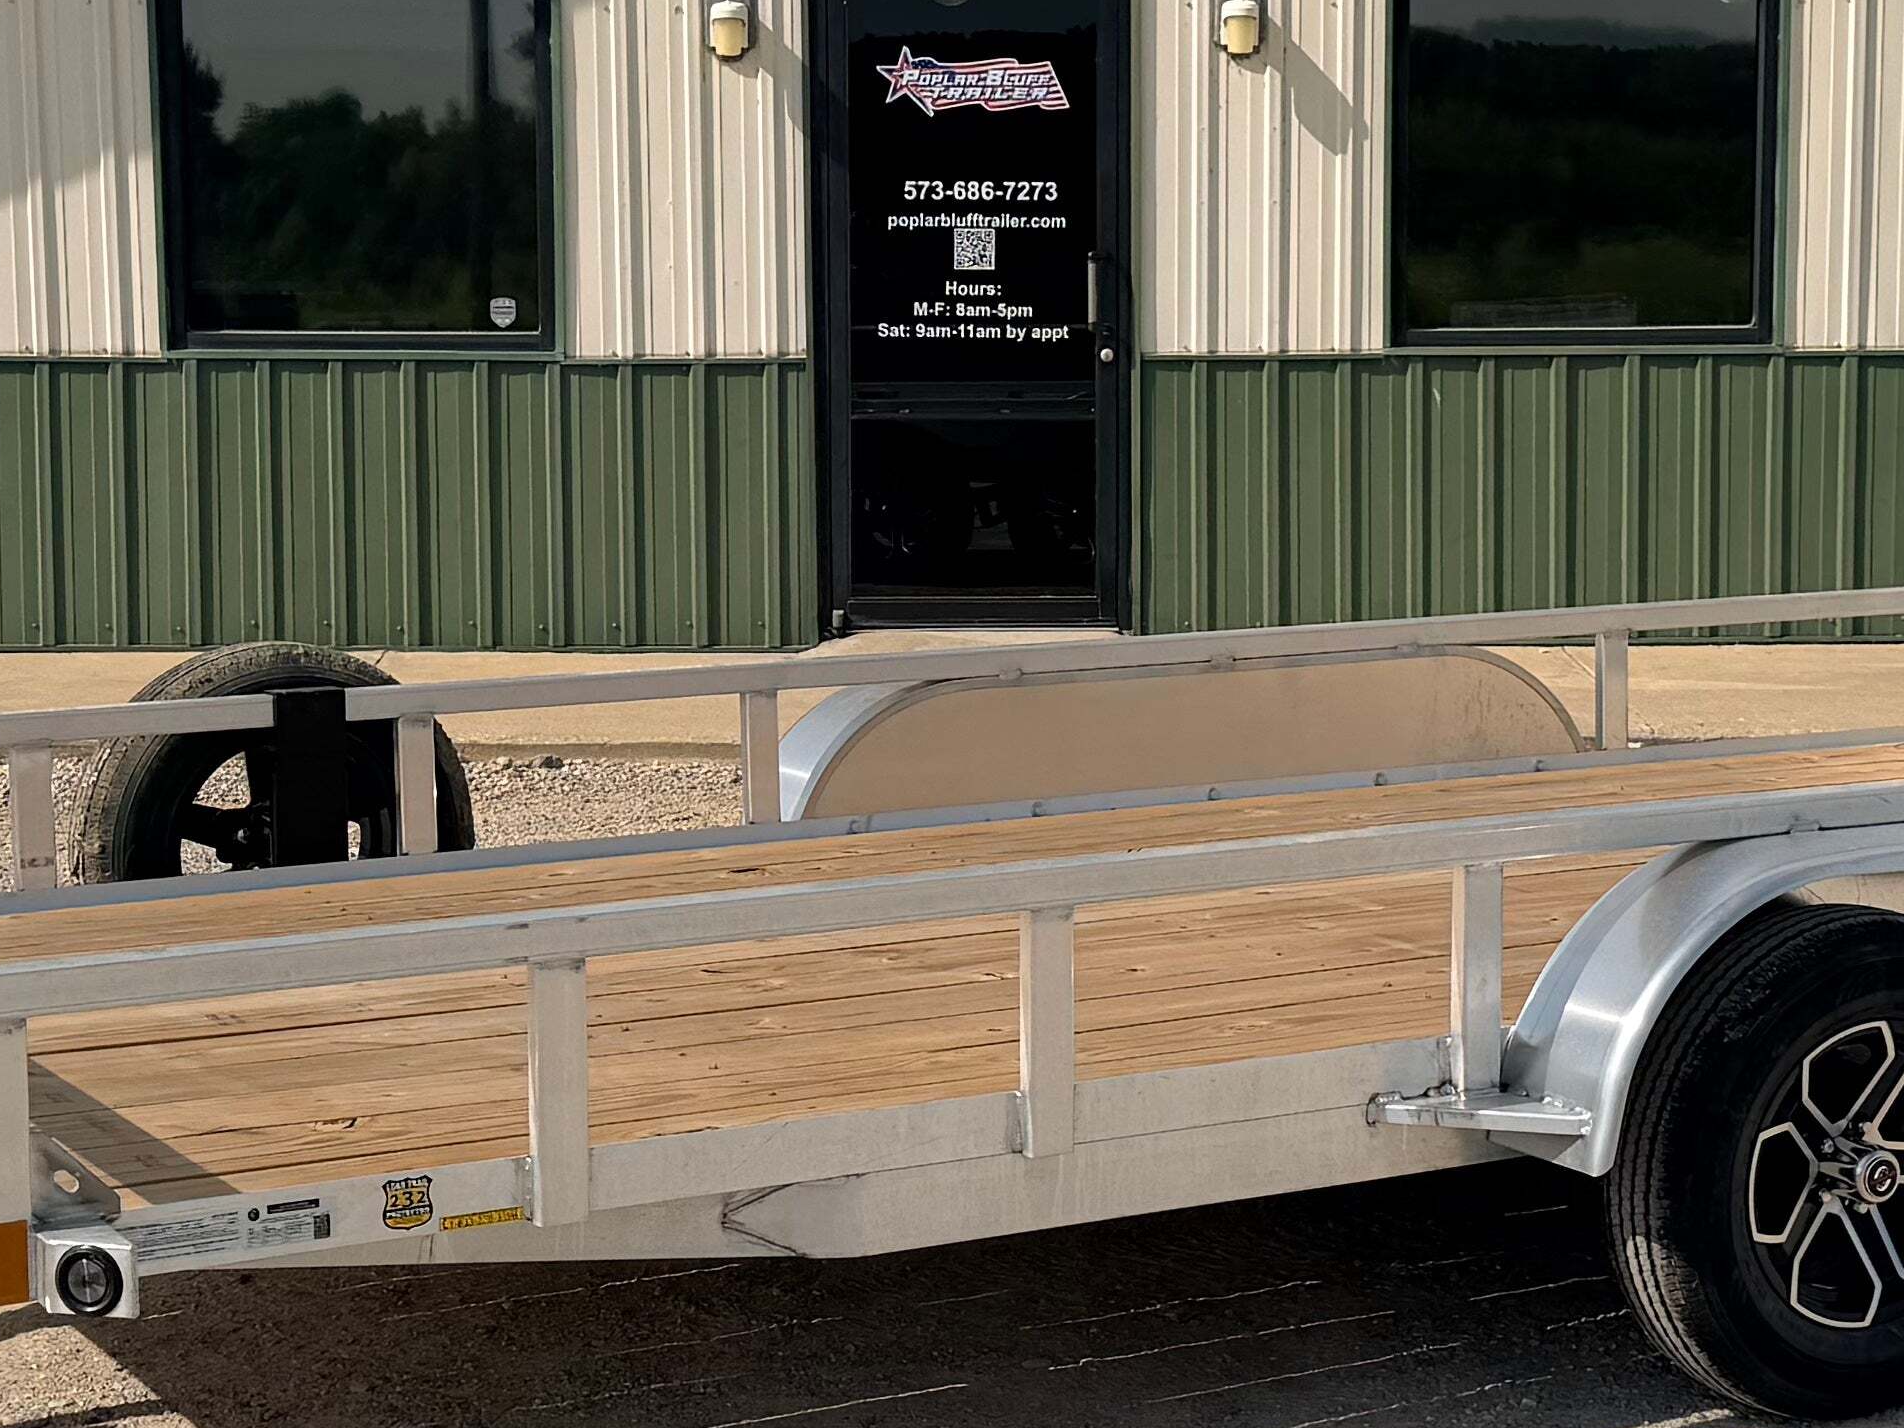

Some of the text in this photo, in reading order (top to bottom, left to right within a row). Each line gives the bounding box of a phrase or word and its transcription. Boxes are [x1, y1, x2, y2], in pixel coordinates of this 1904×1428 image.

[904, 181, 1058, 201] 573-686-7273
[887, 213, 1067, 231] poplarblufftrailer.com
[945, 281, 1002, 297] Hours:
[913, 302, 1034, 320] M-F: 8am-5pm
[877, 323, 1070, 342] Sat: 9am-11am by appt
[390, 1190, 426, 1208] 232
